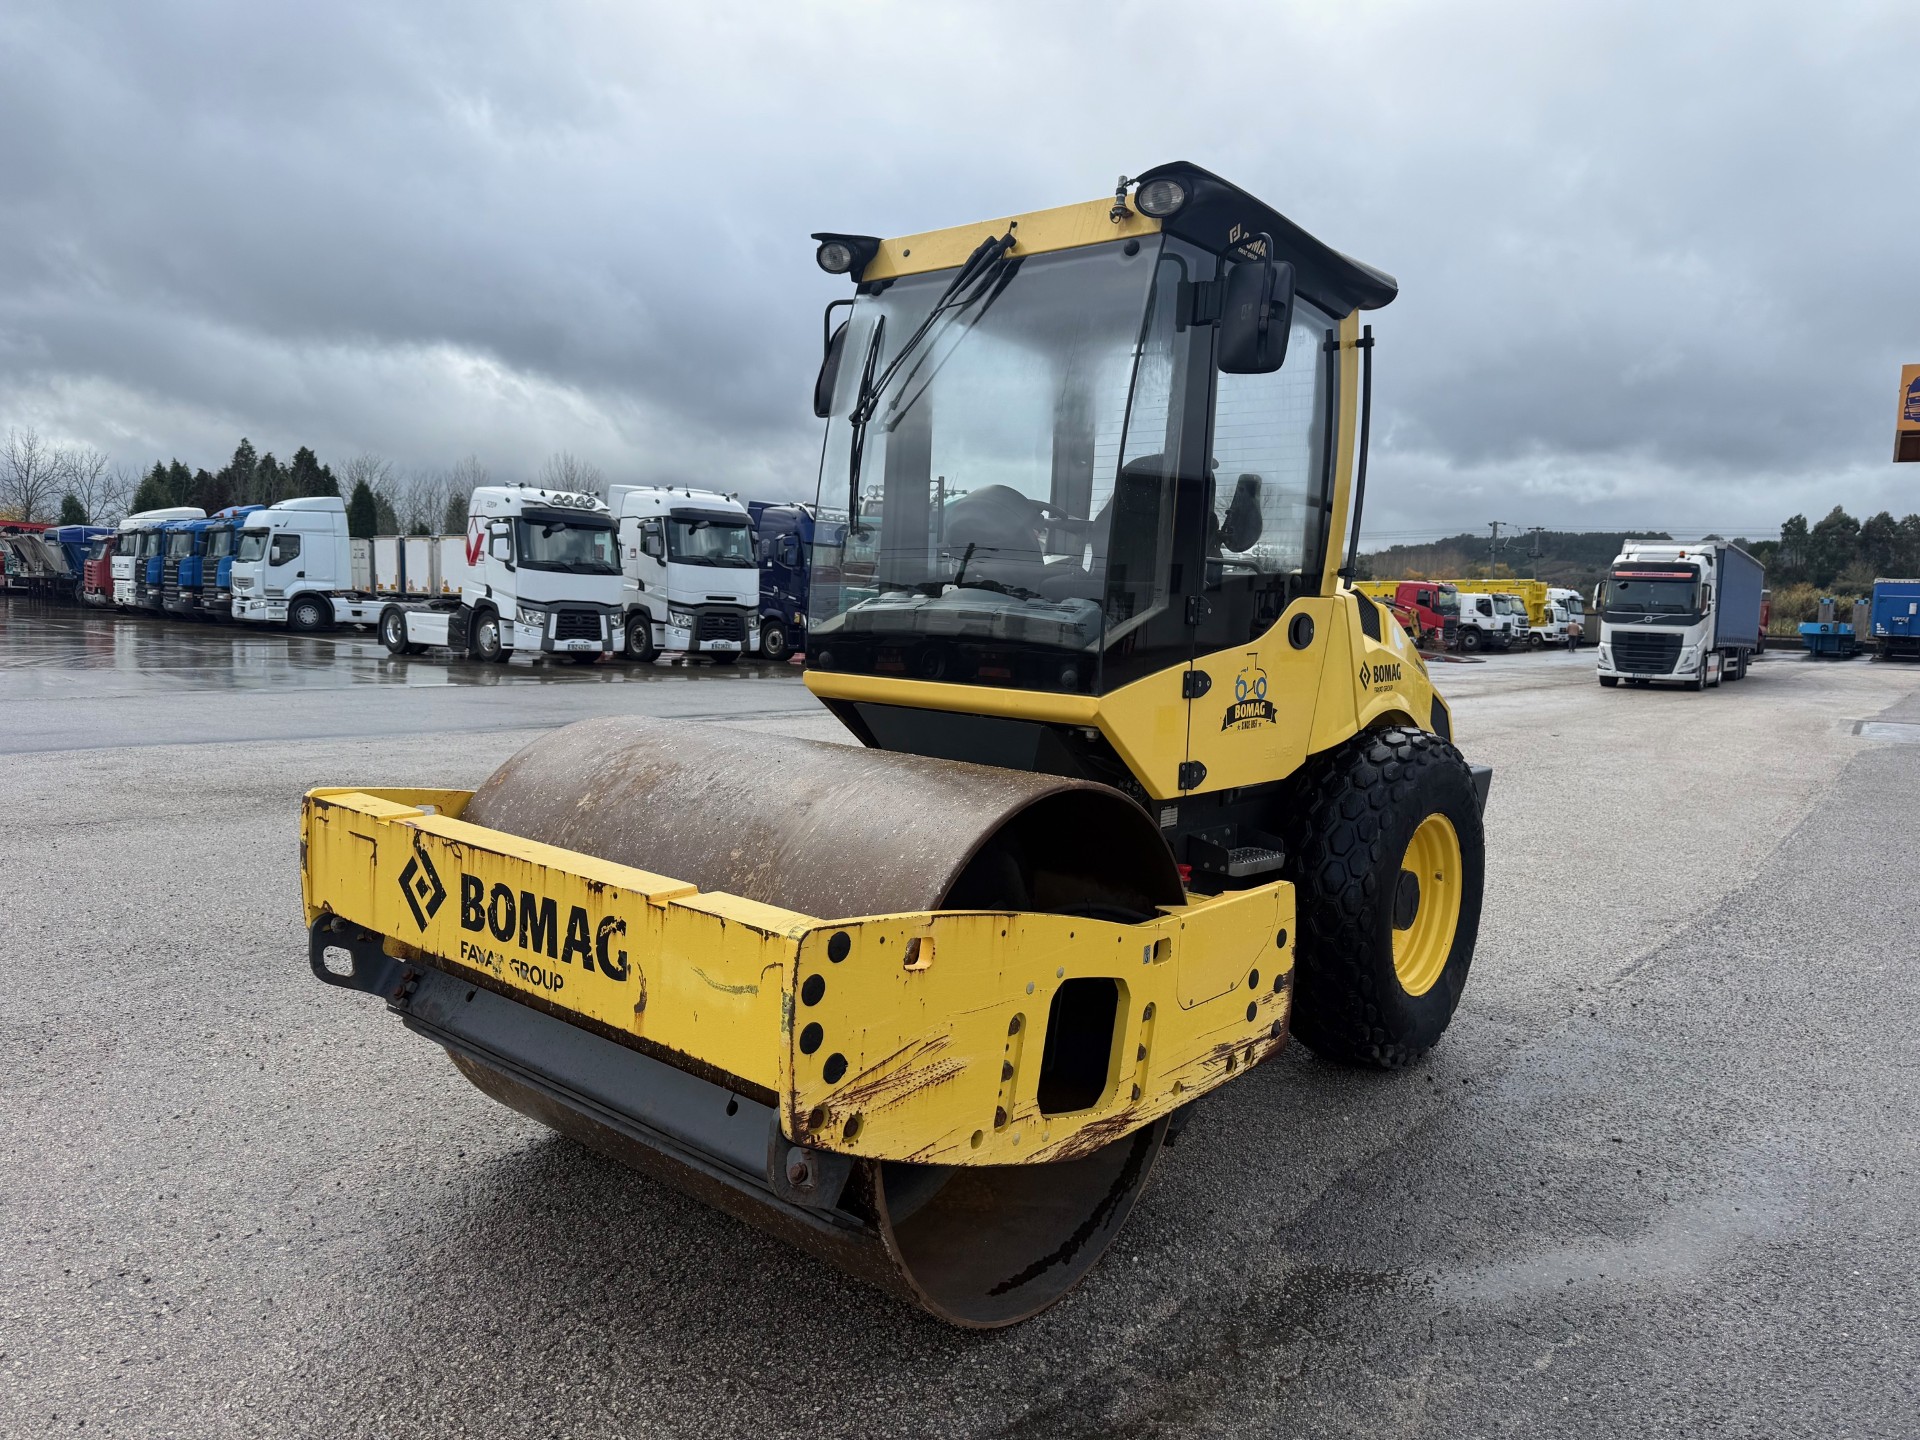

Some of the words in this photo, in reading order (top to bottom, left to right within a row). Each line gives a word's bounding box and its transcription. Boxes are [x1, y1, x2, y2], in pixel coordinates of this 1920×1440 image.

[1373, 662, 1402, 684] BOMAG
[1234, 701, 1266, 719] BOMAG
[461, 872, 628, 982] BOMAG
[509, 958, 564, 992] GROUP
